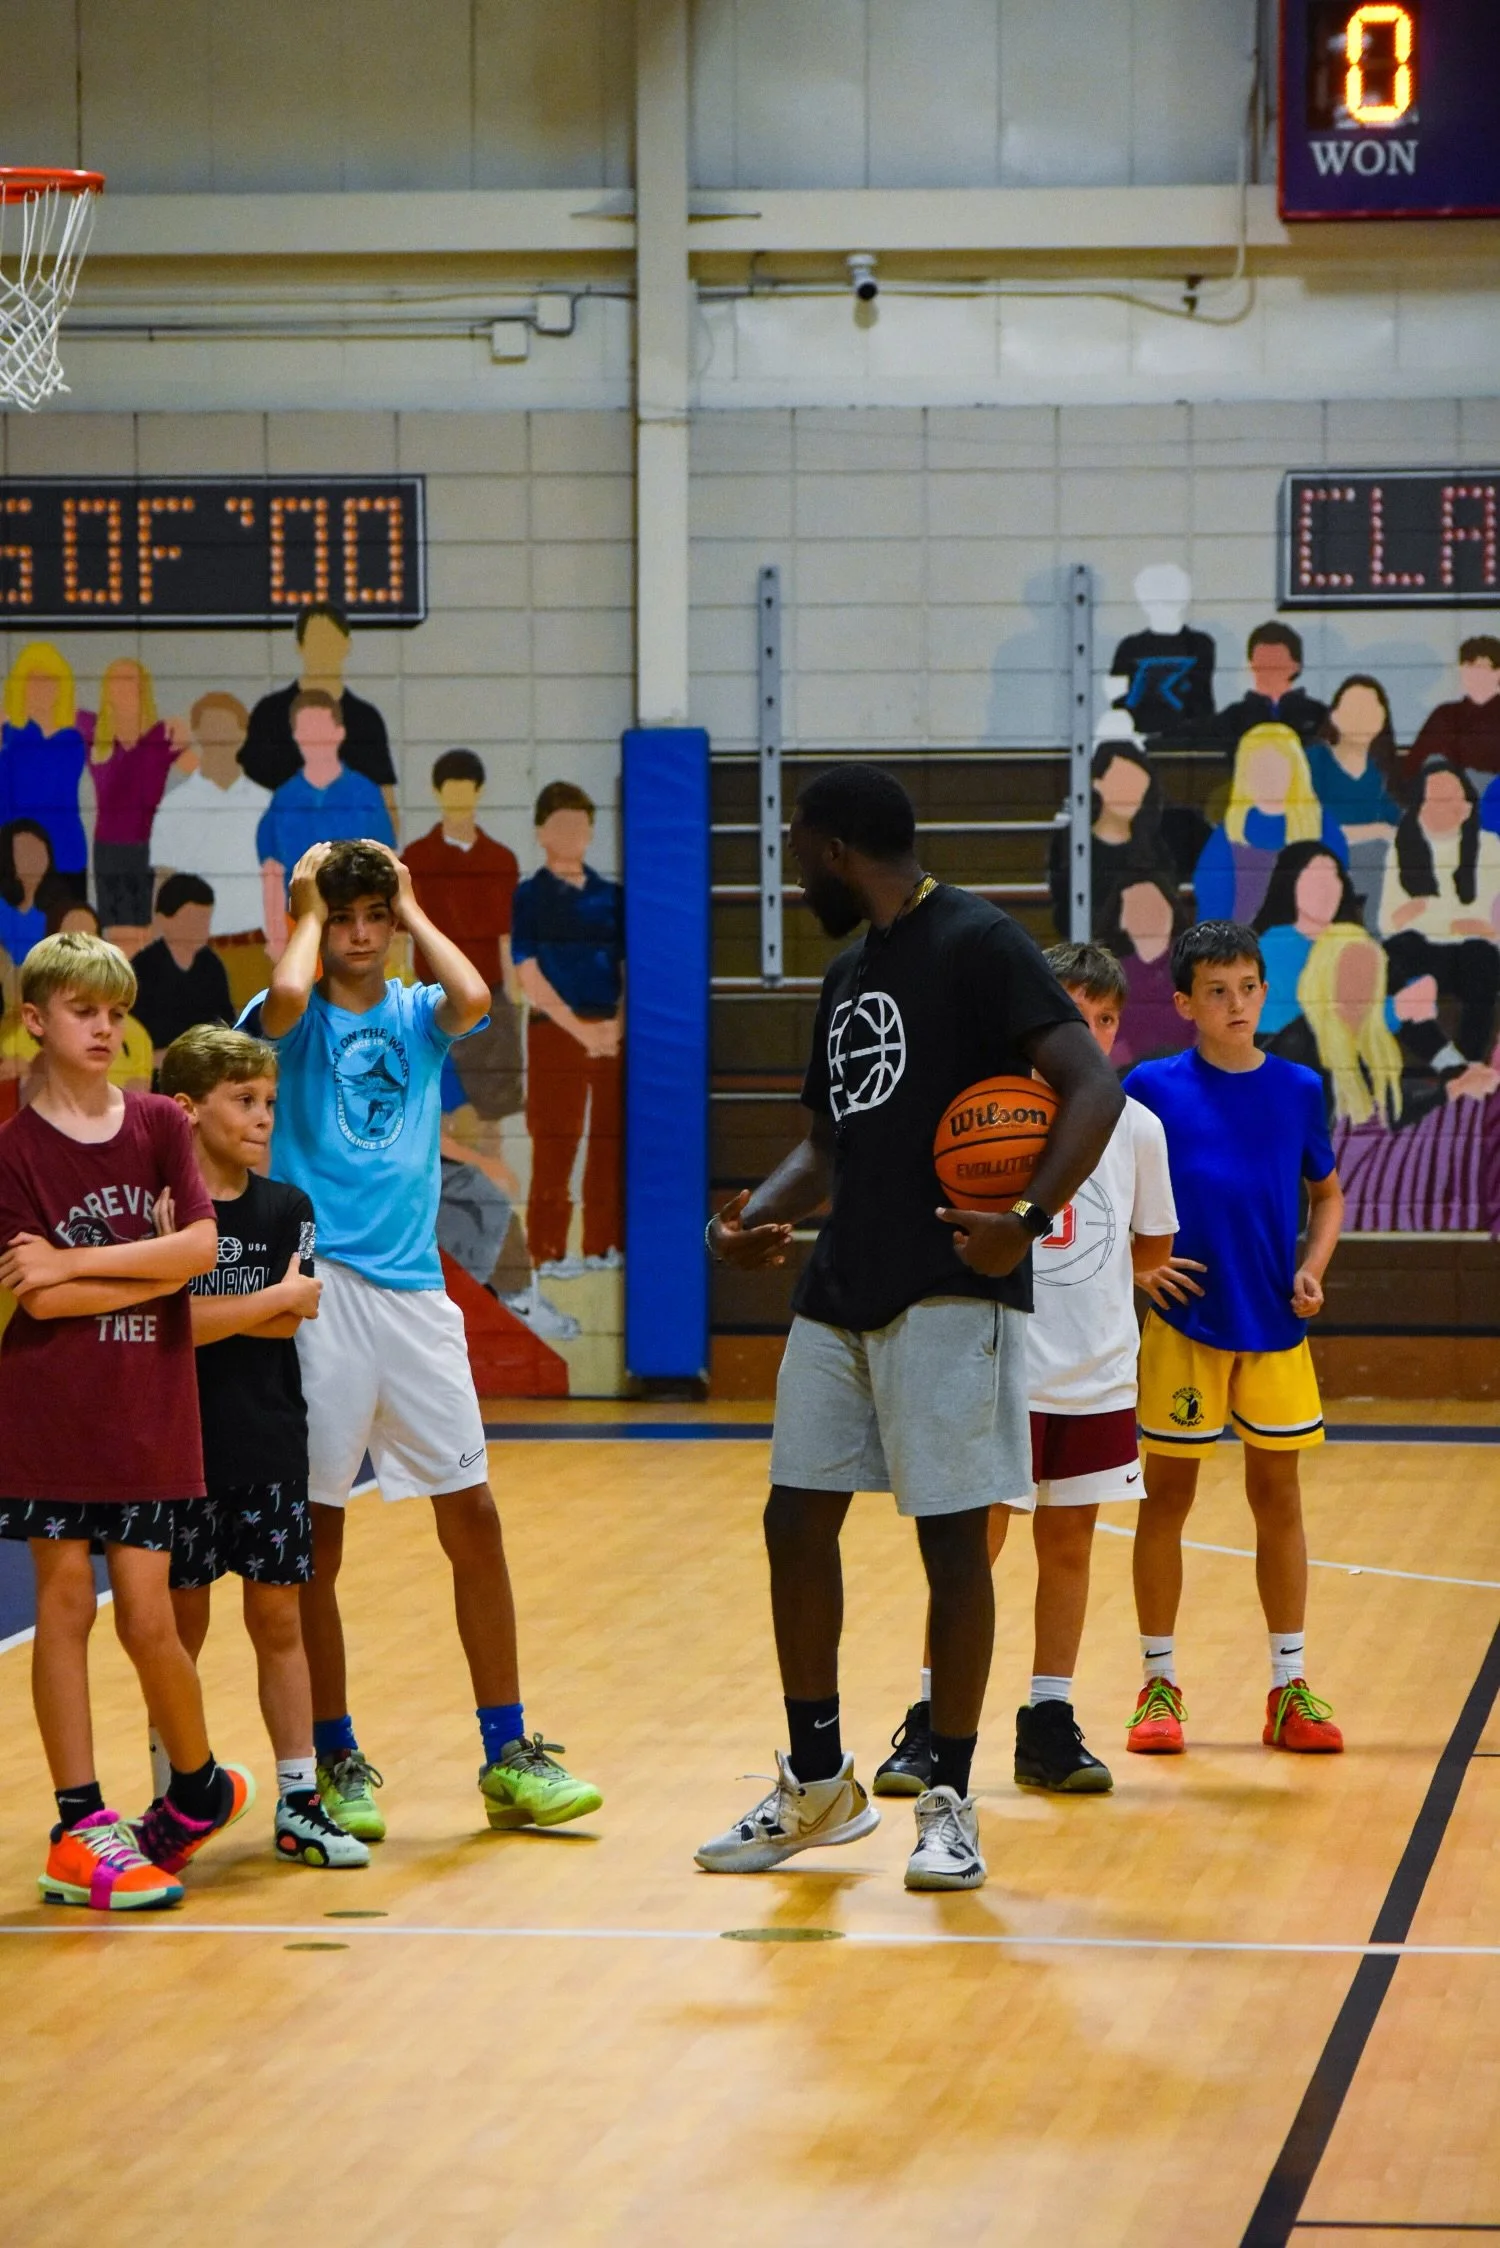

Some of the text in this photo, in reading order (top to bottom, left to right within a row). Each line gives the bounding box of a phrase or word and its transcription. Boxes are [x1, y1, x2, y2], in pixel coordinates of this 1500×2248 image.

[1346, 5, 1412, 123] 0
[1308, 139, 1420, 177] WON
[62, 496, 196, 606] OF
[1299, 485, 1498, 589] CLA
[340, 1031, 357, 1049] ON
[360, 1027, 388, 1039] THE
[950, 1102, 1048, 1136] Wilson
[248, 1243, 267, 1251] USA
[1169, 1412, 1204, 1427] IMPACT
